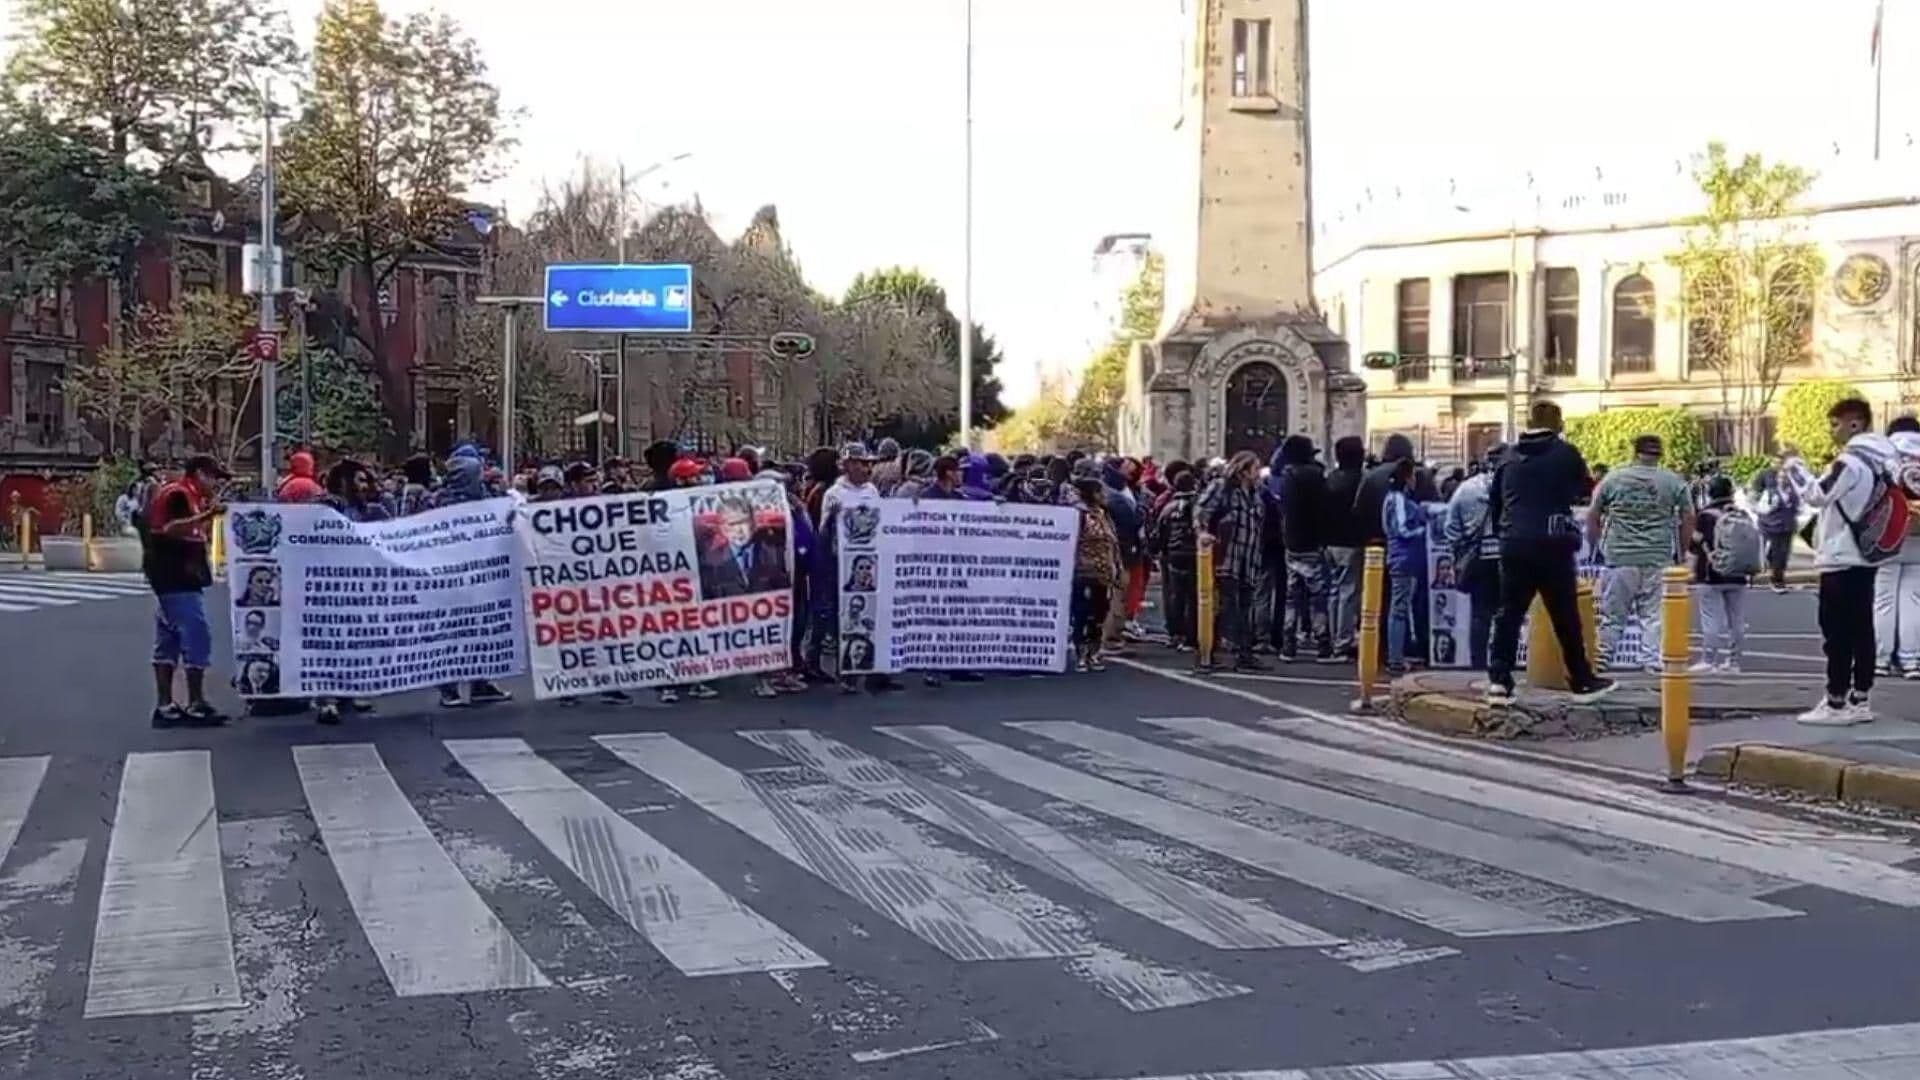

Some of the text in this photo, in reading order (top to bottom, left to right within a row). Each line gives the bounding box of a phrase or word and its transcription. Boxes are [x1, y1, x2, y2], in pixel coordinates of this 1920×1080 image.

[531, 498, 671, 535] CHOFER
[571, 530, 638, 556] QUE
[524, 550, 691, 587] TRASLADABA
[531, 578, 694, 618] POLICIAS
[535, 595, 791, 647] DESAPARECIDOS
[560, 623, 783, 670] DE TEOCALTICHE
[543, 672, 589, 692] Vivos
[593, 673, 611, 686] se
[671, 658, 709, 677] Vivos
[711, 656, 730, 671] los
